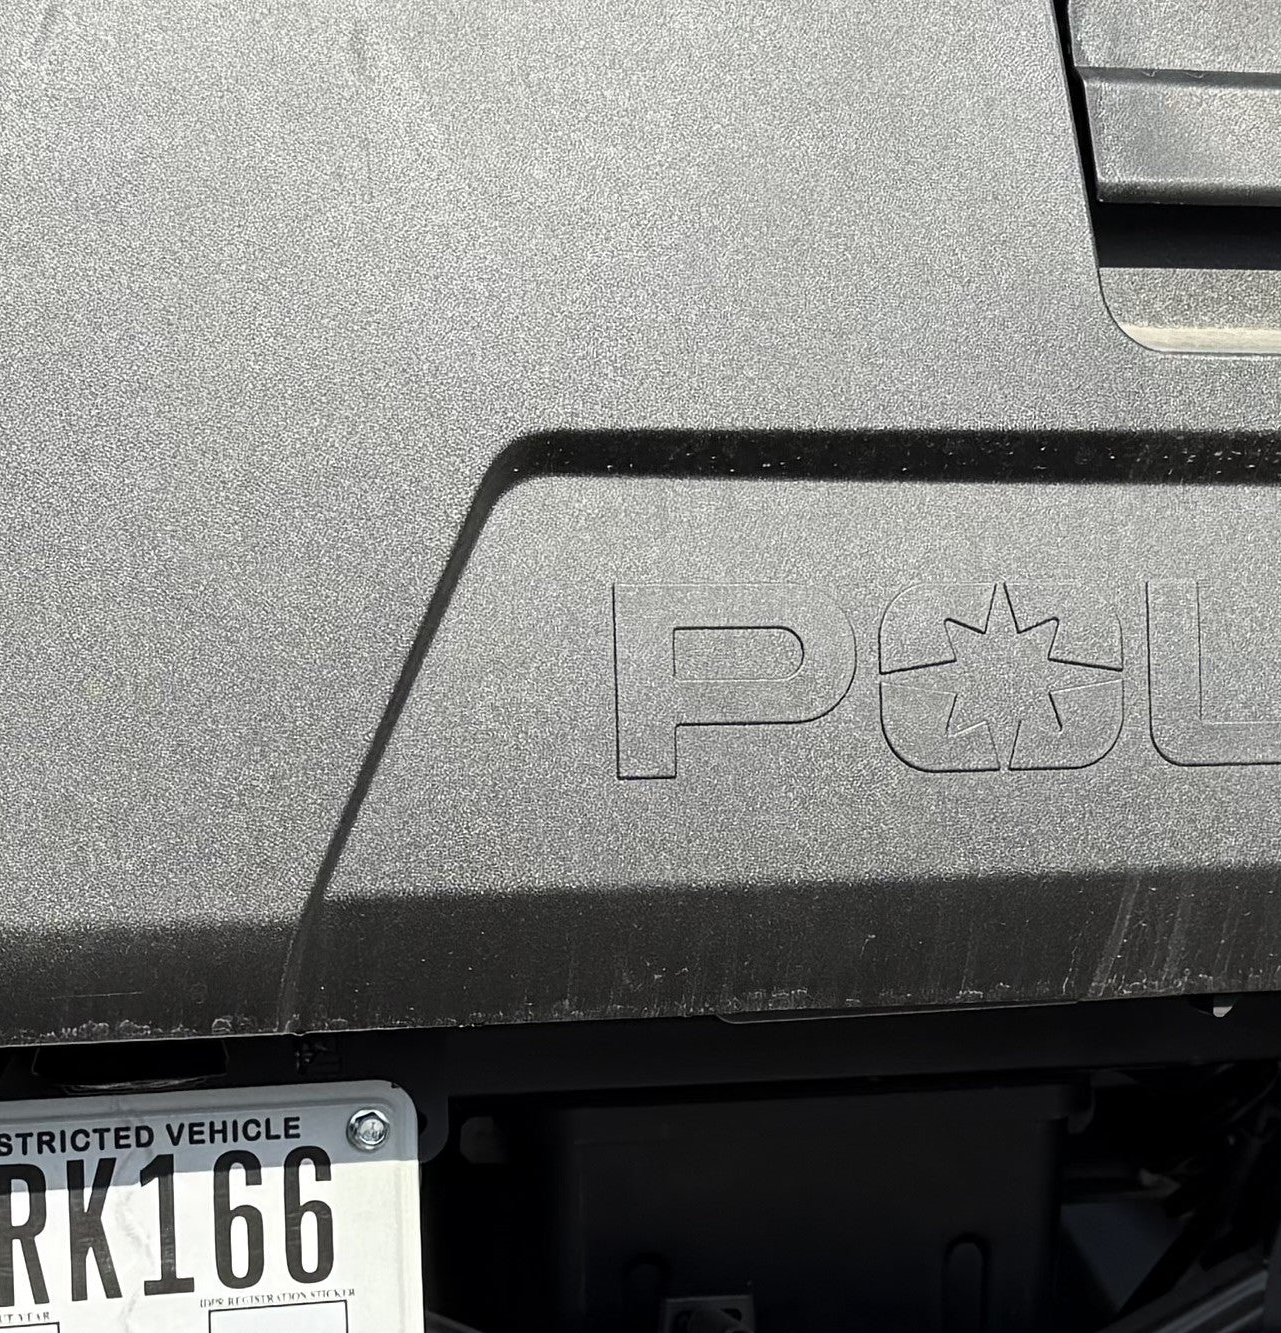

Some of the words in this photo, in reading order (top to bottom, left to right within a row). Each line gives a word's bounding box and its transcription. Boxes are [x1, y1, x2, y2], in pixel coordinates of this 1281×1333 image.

[165, 1116, 301, 1147] VEHICLE
[227, 1292, 306, 1306] REGISTRATION
[310, 1288, 356, 1300] STICKER
